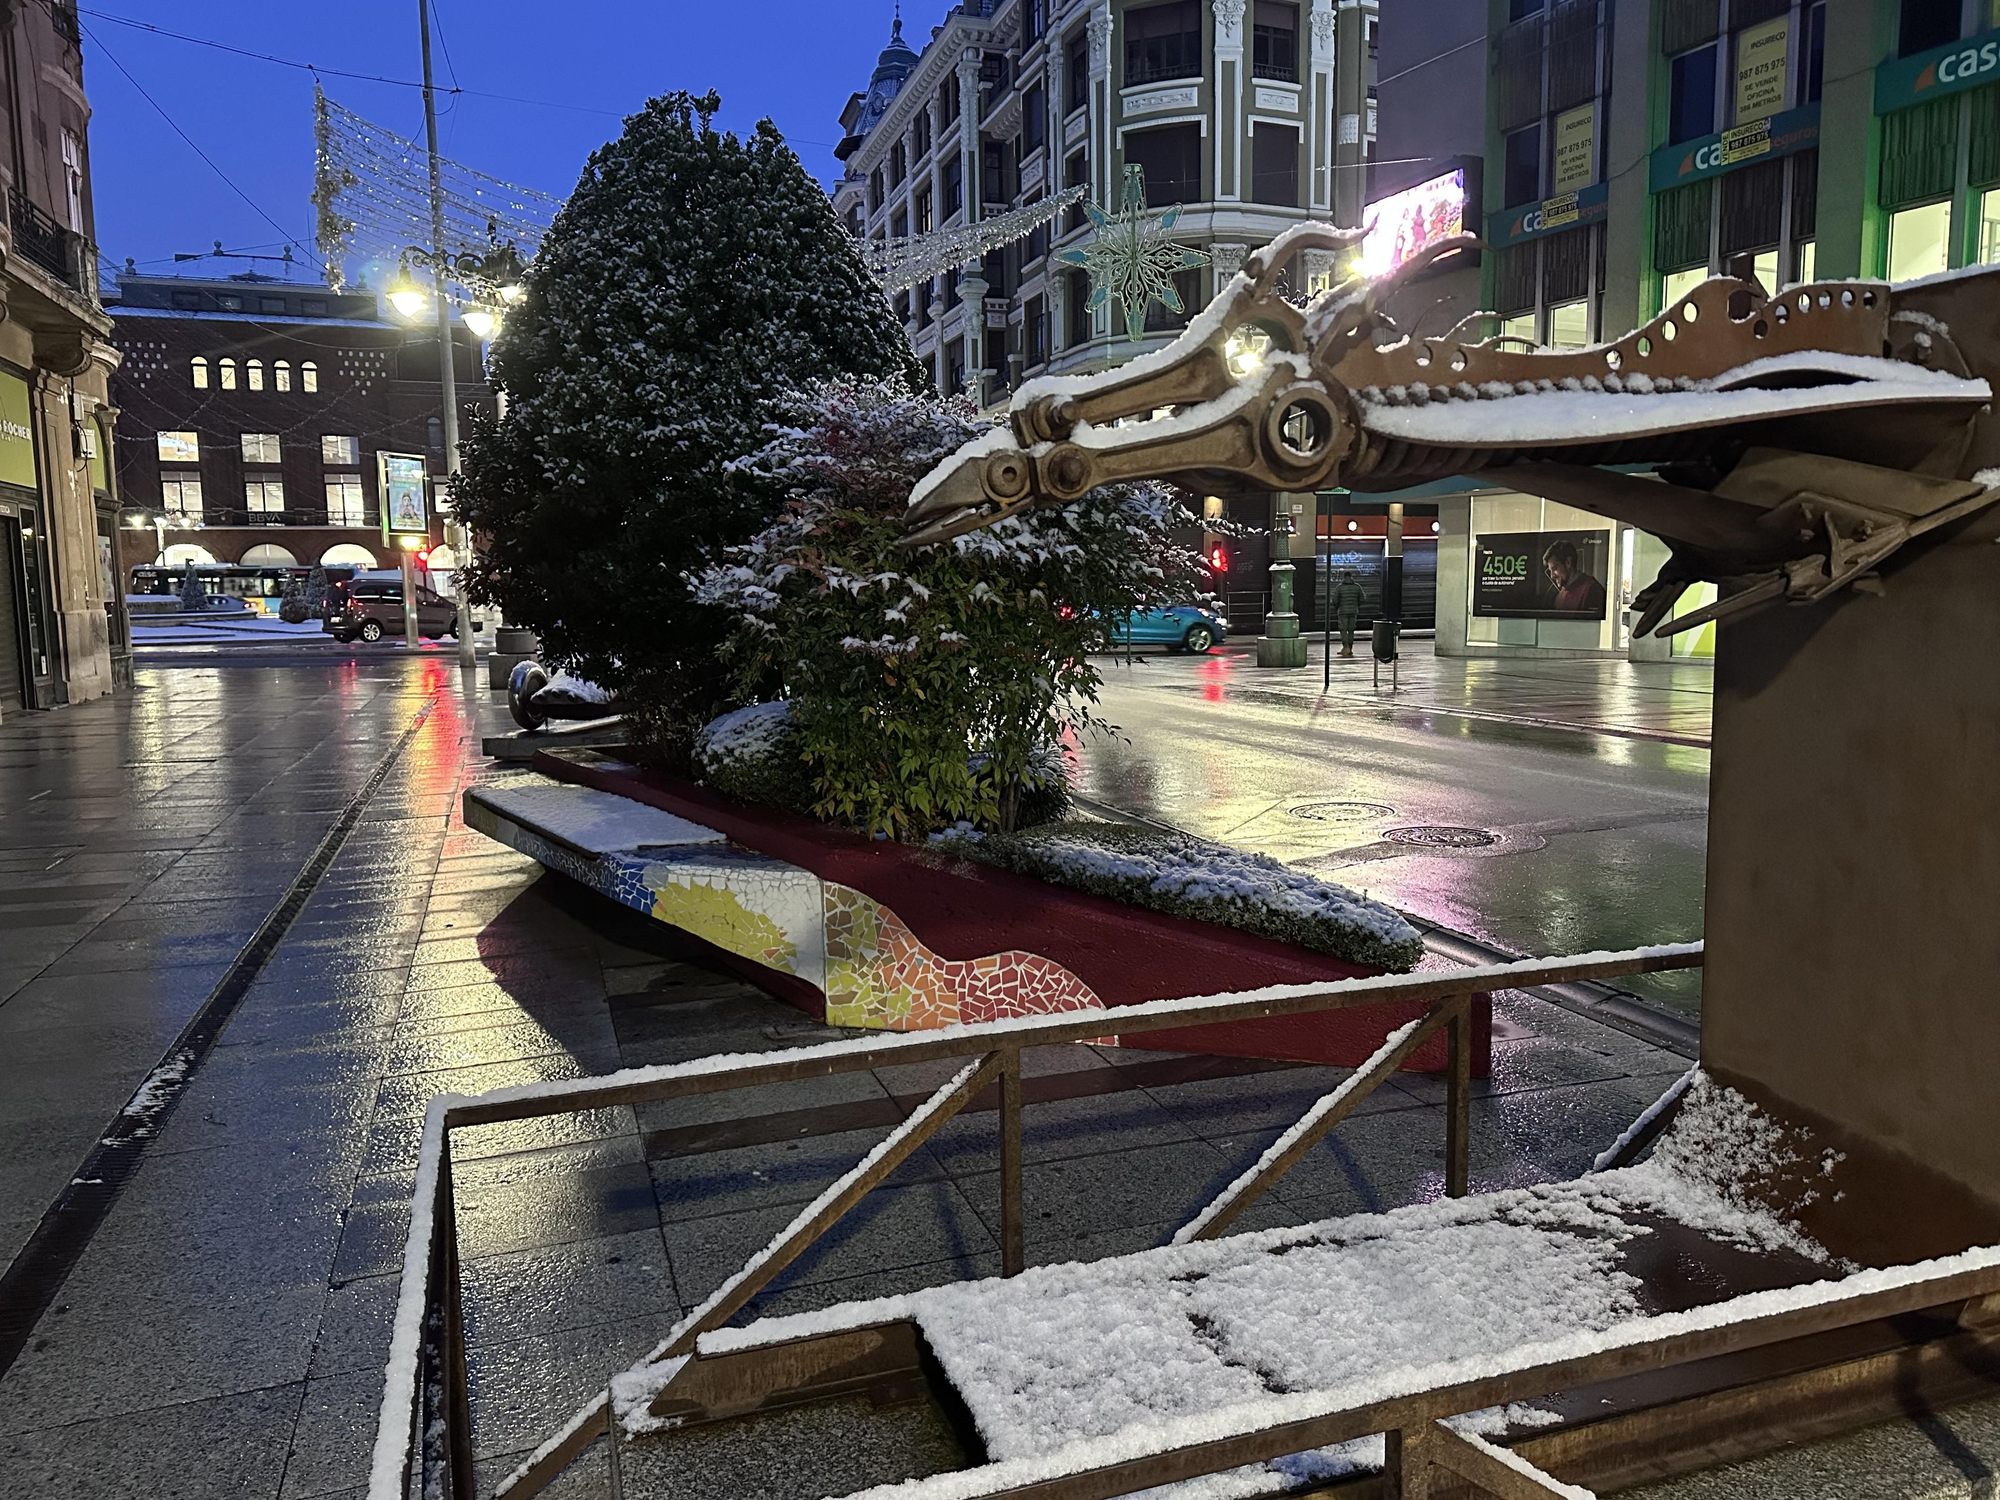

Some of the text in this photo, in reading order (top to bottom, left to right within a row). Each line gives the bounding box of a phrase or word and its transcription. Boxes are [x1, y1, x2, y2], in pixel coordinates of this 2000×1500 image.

[1751, 31, 1785, 49] INSURECO
[1739, 57, 1785, 81] 987 875 975
[1938, 42, 2000, 82] cas
[1745, 74, 1779, 91] SE VENDE
[1747, 87, 1775, 100] OFICINA
[1752, 94, 1781, 109] METROS
[1565, 116, 1592, 130] INSURECO
[1731, 121, 1763, 139] INSURECO
[1557, 138, 1592, 157] 987 875 975
[1731, 131, 1769, 150] 987 875 975
[1568, 153, 1587, 163] VENDE
[1563, 163, 1584, 174] OFICINA
[1567, 169, 1589, 180] METROS
[1549, 195, 1573, 207] INSURECO
[3, 420, 32, 441] ROCHER
[249, 513, 281, 522] BBVA
[1483, 555, 1528, 575] 450€
